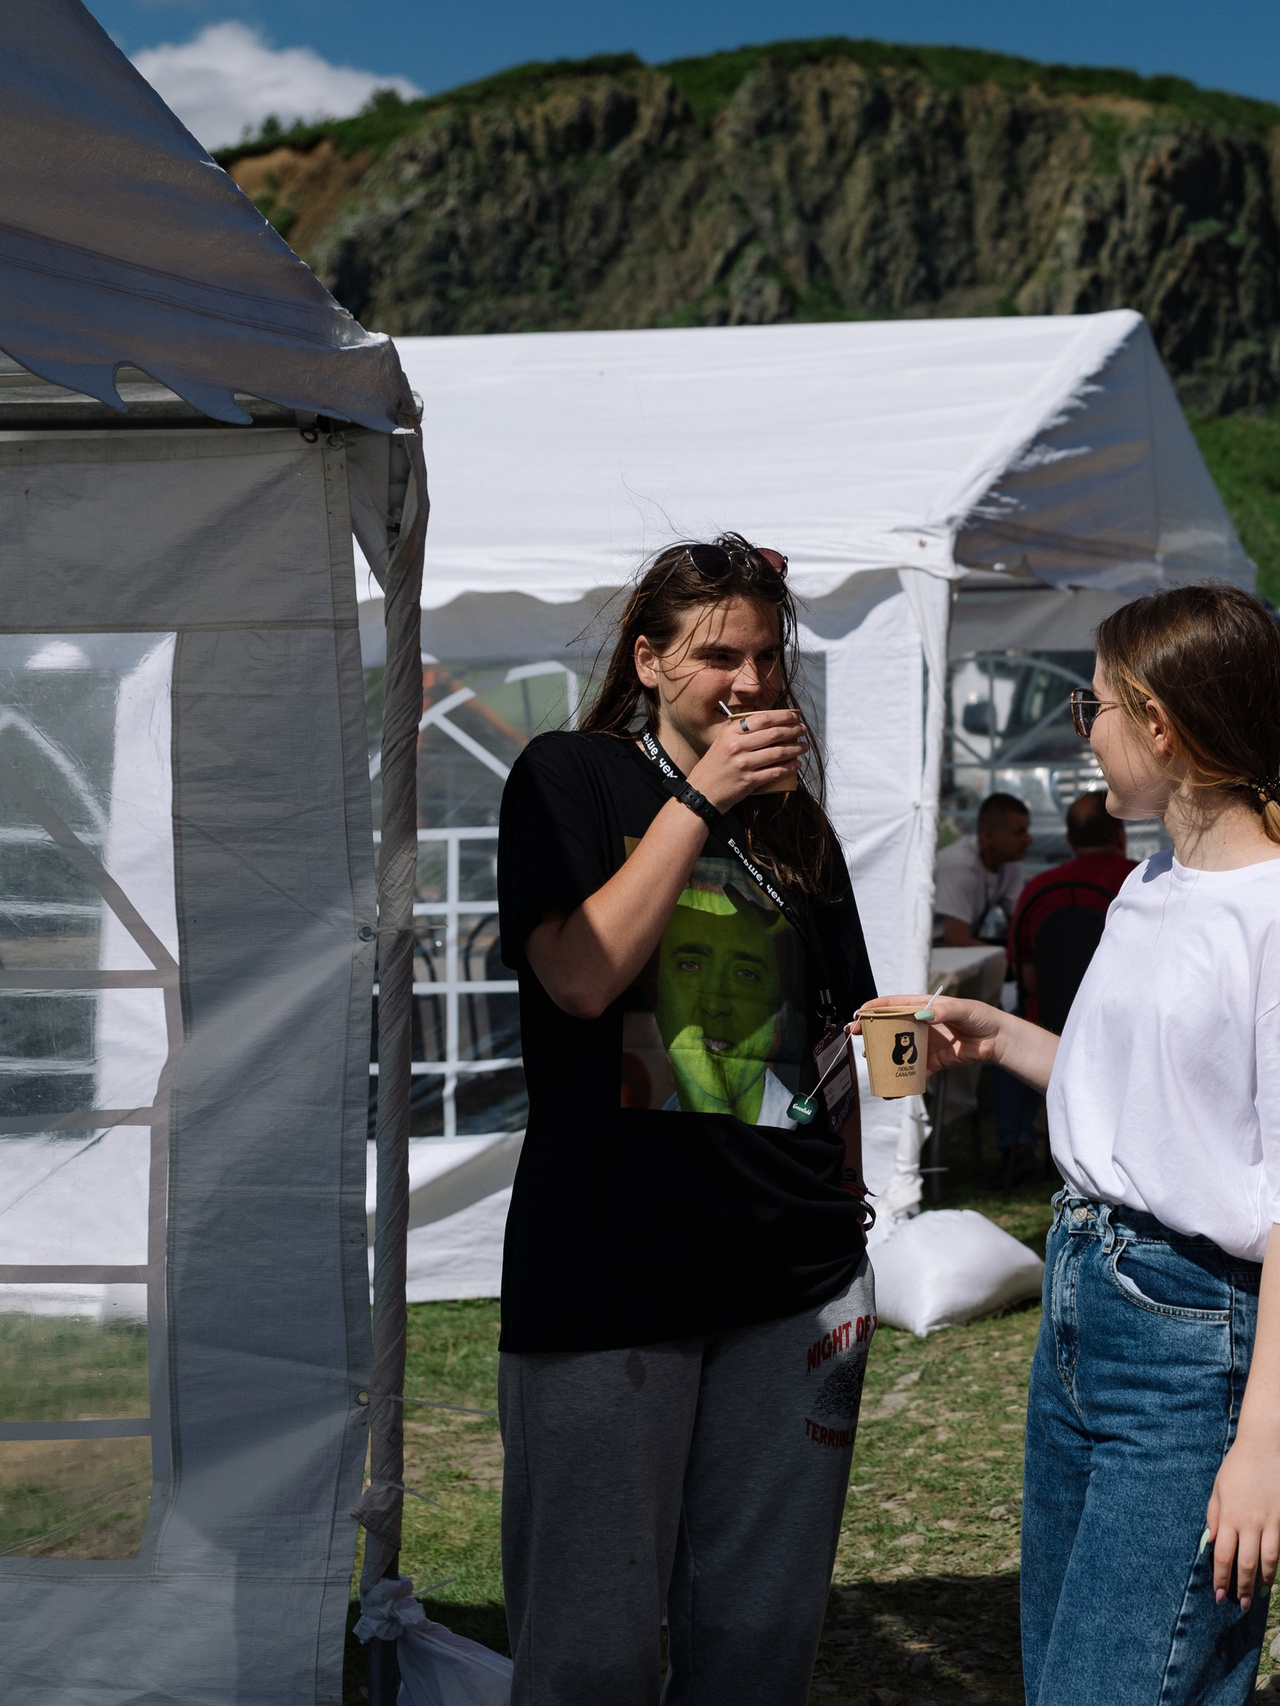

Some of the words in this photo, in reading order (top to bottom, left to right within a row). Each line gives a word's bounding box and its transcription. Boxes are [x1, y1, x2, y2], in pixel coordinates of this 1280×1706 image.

[727, 838, 764, 886] Больше,
[765, 883, 785, 907] чем
[806, 1321, 852, 1376] NIGHT
[856, 1314, 871, 1342] OF
